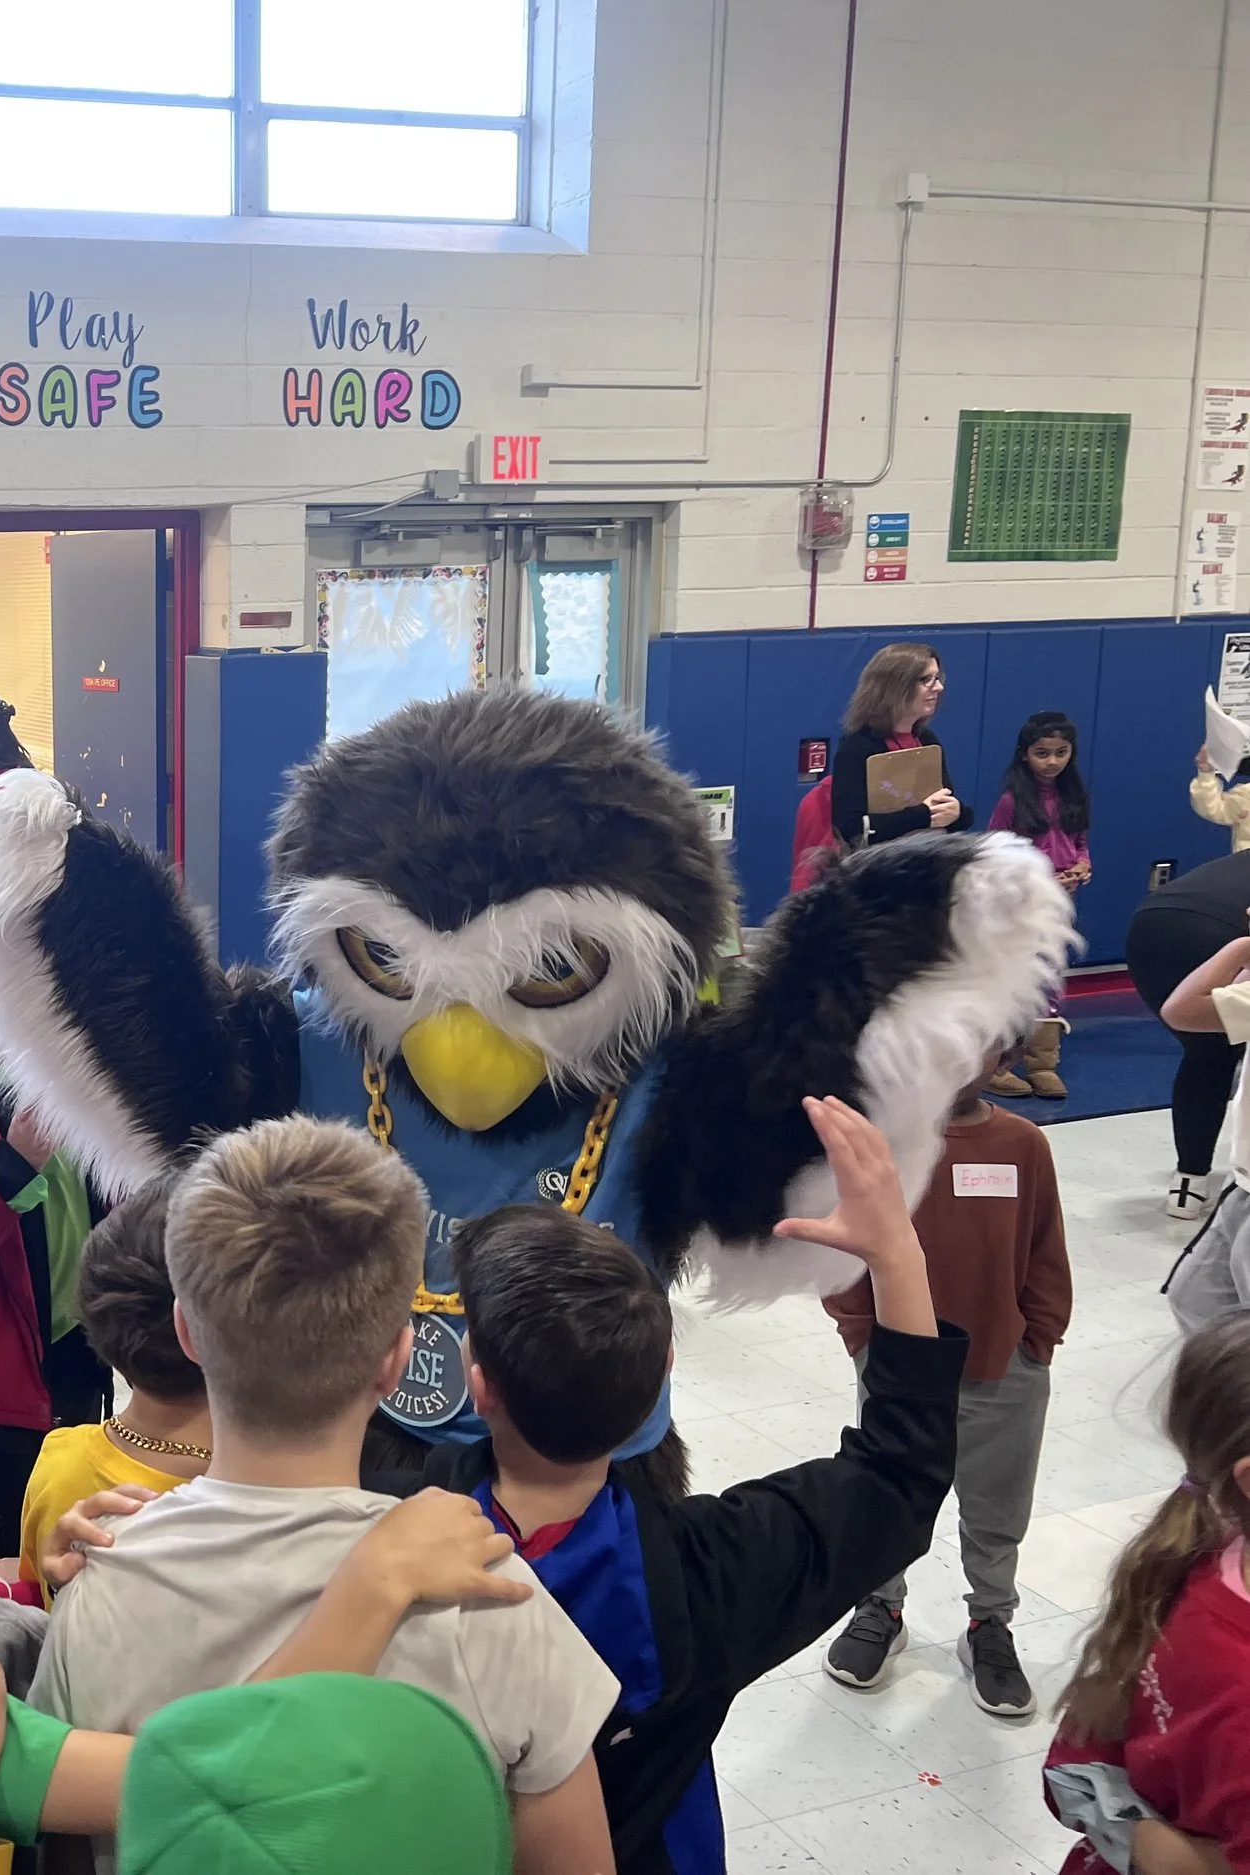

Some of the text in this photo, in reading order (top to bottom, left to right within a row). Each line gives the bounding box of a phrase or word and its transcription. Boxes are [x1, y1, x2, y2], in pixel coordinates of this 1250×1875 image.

[28, 290, 144, 367] Play
[307, 297, 427, 357] Work
[282, 367, 461, 431] HARD
[493, 436, 541, 480] EXIT
